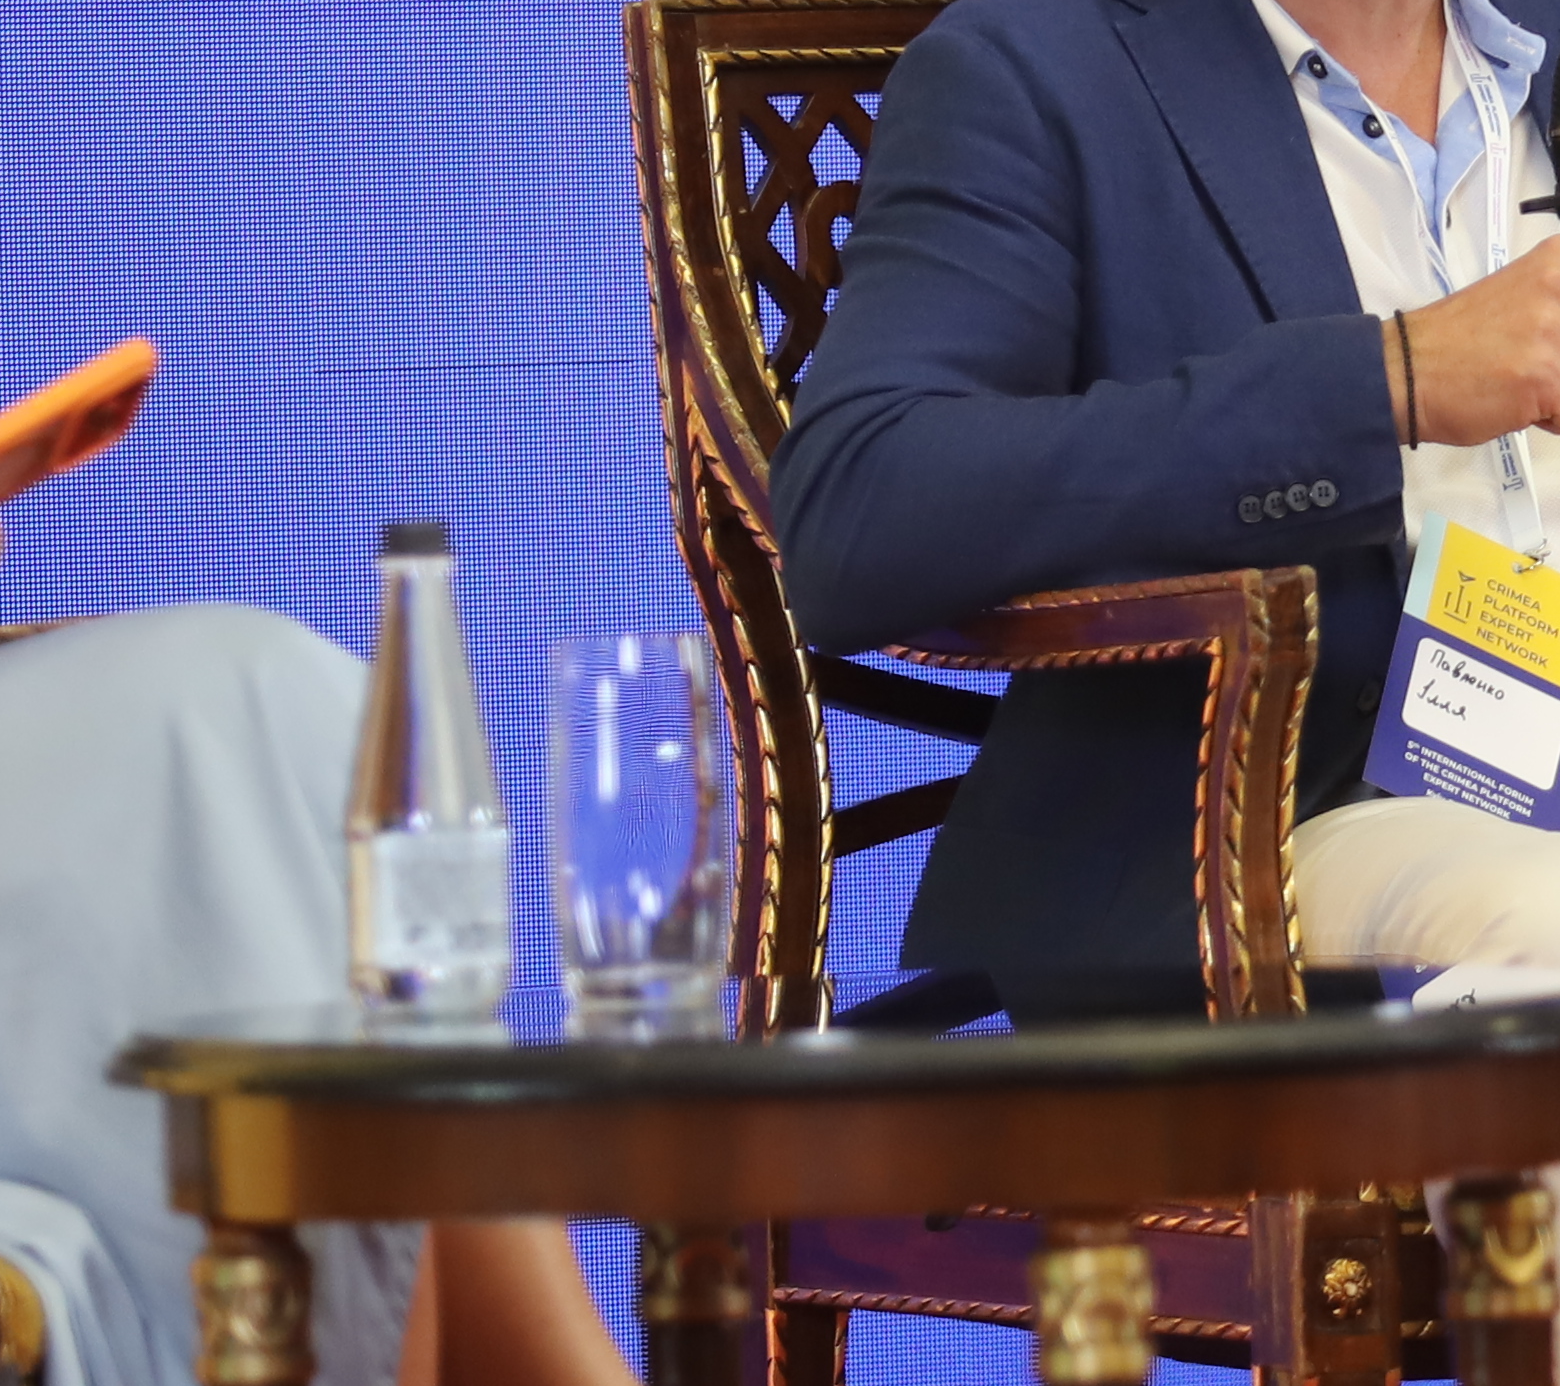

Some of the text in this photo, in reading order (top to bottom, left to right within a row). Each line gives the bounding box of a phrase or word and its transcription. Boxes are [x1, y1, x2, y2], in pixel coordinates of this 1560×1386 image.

[1483, 594, 1559, 639] PLATFORM
[1487, 579, 1541, 612] CRIMEA
[1476, 627, 1548, 669] NETWORK
[1480, 611, 1533, 642] EXPERT
[1404, 751, 1532, 818] OF THE CRIMEA PLATFORM
[1420, 746, 1497, 789] INTERNATIONAL
[1498, 783, 1535, 806] FORUM
[1423, 772, 1461, 795] EXPERT
[1461, 790, 1511, 819] NETWORK
